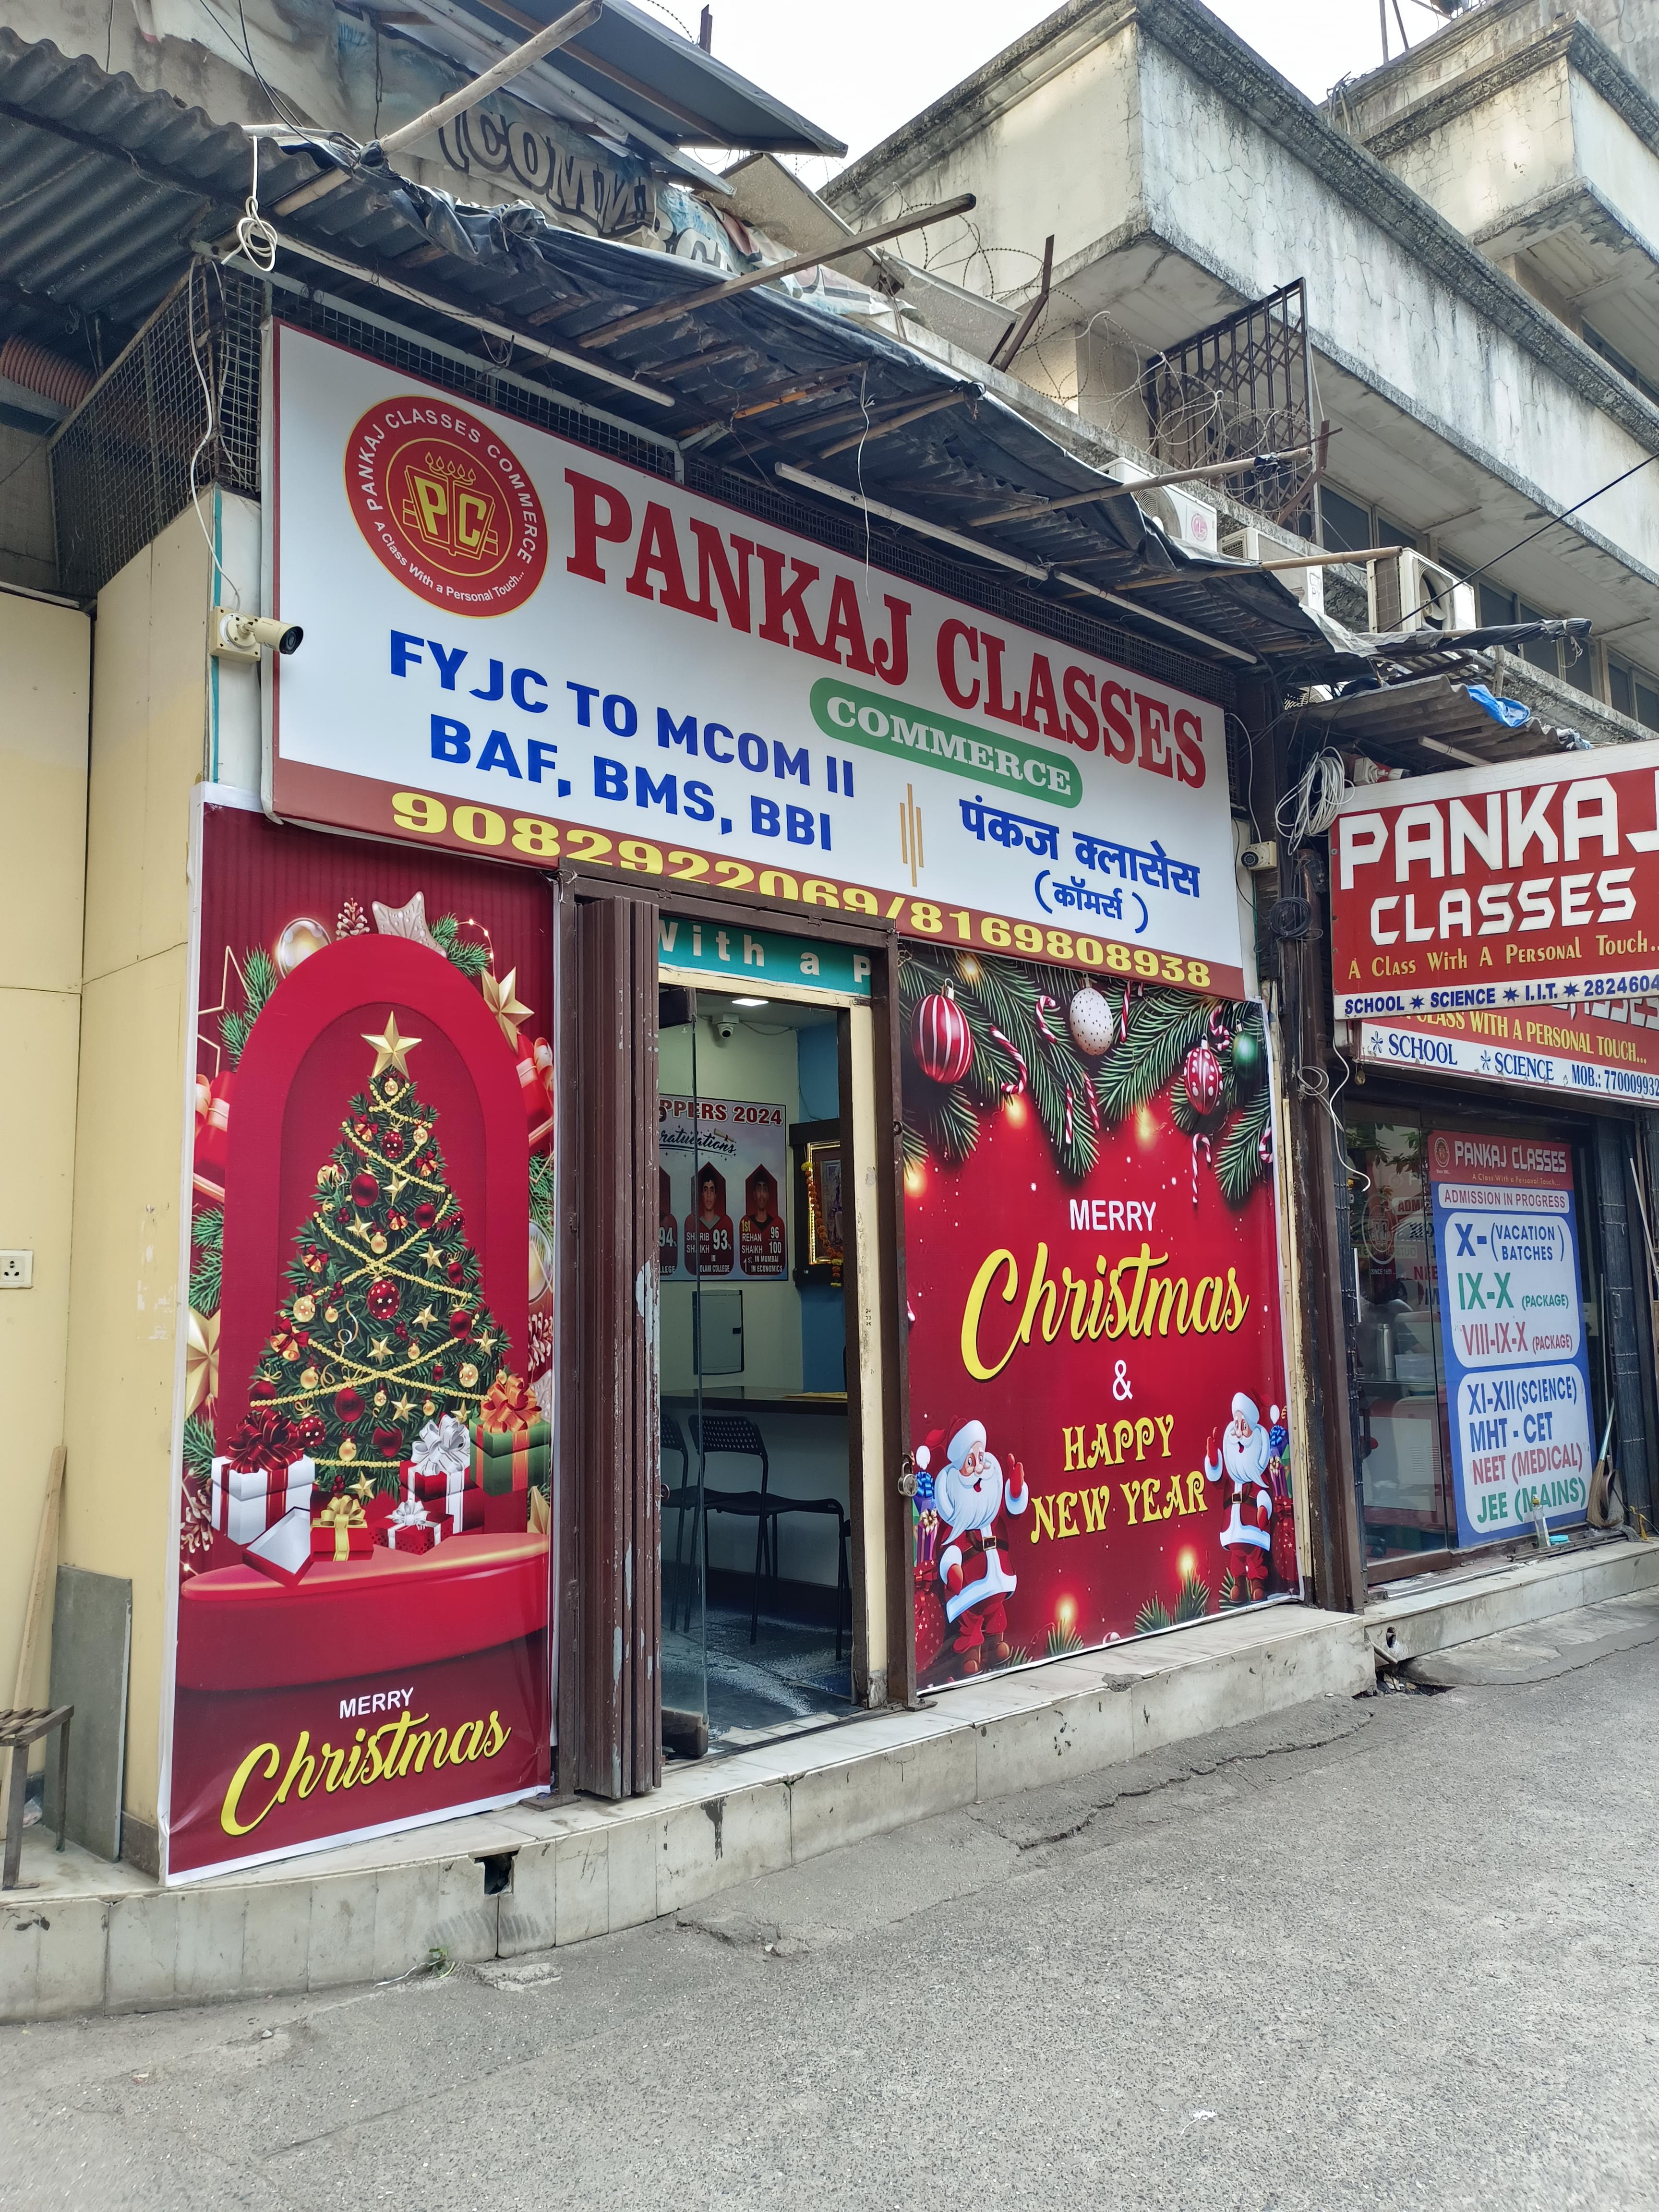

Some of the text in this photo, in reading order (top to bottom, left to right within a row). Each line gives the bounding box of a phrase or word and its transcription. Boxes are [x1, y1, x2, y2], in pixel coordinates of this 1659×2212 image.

[359, 408, 538, 565] PANKAJ CLASSES COMMERCE
[374, 521, 385, 531] A
[382, 533, 408, 566] Class
[409, 563, 434, 589] With
[436, 584, 444, 594] a
[446, 586, 493, 602] Personal
[565, 467, 1206, 790] PANKAJ CLASSES
[566, 681, 638, 738] TO
[657, 706, 810, 787] MCOM
[826, 755, 854, 798] II
[827, 696, 1072, 796] COMMERCE
[431, 713, 832, 852] BAF, BMS, BBI
[959, 794, 1201, 898] पंकज क्लासेस
[1339, 769, 1659, 890] PANKAJ
[1370, 867, 1637, 946] CLASSES
[800, 952, 820, 976] a
[1348, 960, 1361, 980] A
[1479, 946, 1493, 967] A
[1345, 996, 1405, 1015] SCHOOL
[1431, 987, 1496, 1008] SCIENCE
[1526, 983, 1558, 1001] I.I.T.
[1389, 1034, 1458, 1065] SCHOOL
[1494, 1052, 1554, 1081] SCIENCE
[1469, 1011, 1508, 1038] WITH
[1513, 1019, 1523, 1041] A
[1527, 1021, 1594, 1054] PERSONAL
[1597, 1035, 1647, 1064] TOUCH...
[733, 1106, 783, 1125] 2024
[1454, 1141, 1567, 1173] PANKAJ CLASSES
[1445, 1190, 1565, 1208] ADMISSION IN PROGRESS
[1515, 1176, 1539, 1184] Personal
[770, 1226, 780, 1238] 96
[1070, 1199, 1156, 1231] MERRY
[742, 1233, 762, 1242] REHAN
[742, 1245, 763, 1254] SHAIKH
[769, 1241, 781, 1253] 100
[961, 1242, 1250, 1381] Christmas
[1458, 1273, 1514, 1310] IX-X
[1522, 1294, 1569, 1311] (PACKAGE)
[1462, 1322, 1573, 1356] VIII-IX-X (PACKAGE)
[1112, 1359, 1133, 1401] &
[1062, 1414, 1175, 1472] HAPPY
[1469, 1418, 1507, 1453] MHT
[1524, 1411, 1552, 1443] CET
[1472, 1442, 1583, 1485] NEET (MEDICAL)
[1031, 1470, 1209, 1544] NEW YEAR
[1477, 1477, 1586, 1523] JEE (MAINS)
[339, 1687, 414, 1719] MERRY
[220, 1710, 512, 1837] Christmas
